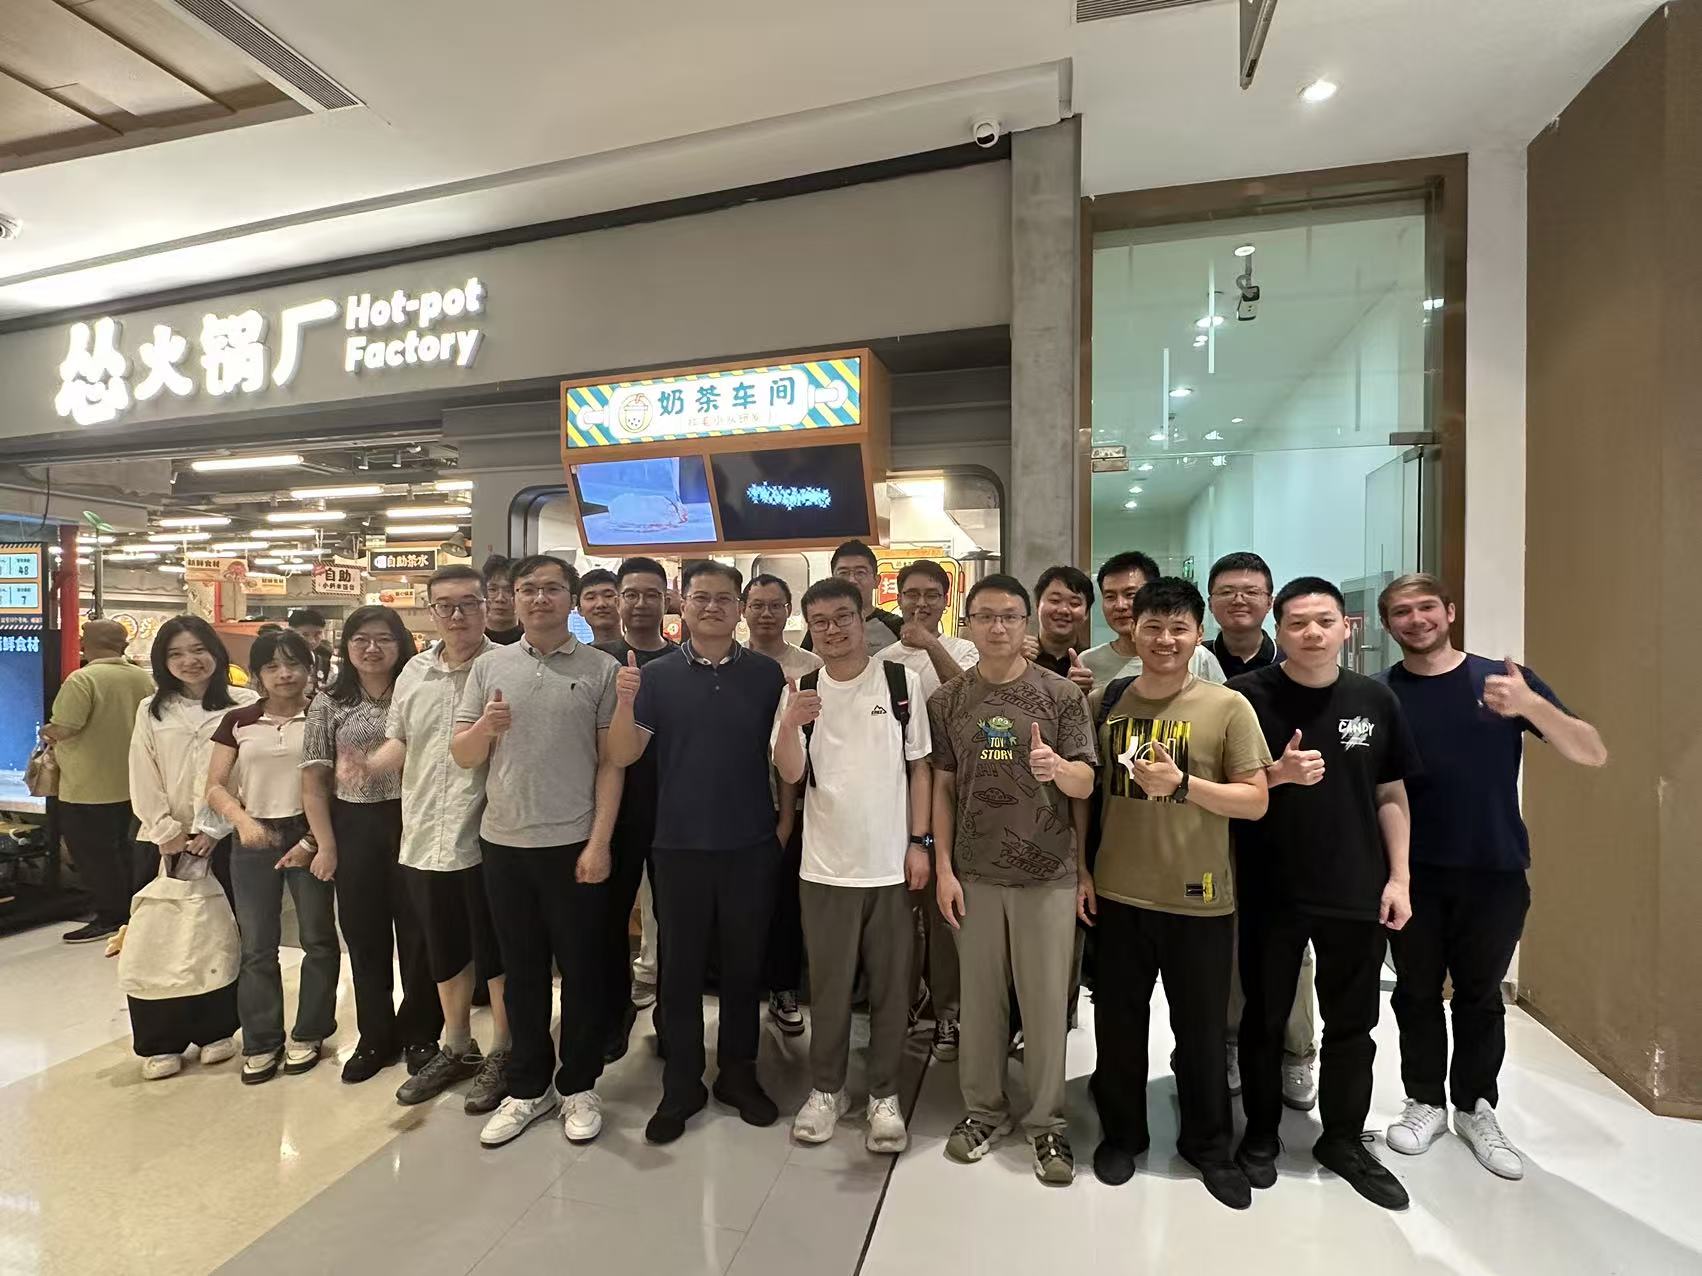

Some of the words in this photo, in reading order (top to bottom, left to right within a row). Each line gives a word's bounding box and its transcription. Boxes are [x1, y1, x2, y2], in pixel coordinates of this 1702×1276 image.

[345, 277, 485, 330] Hot-pot
[345, 329, 481, 373] Factory
[54, 298, 341, 426] 怂火锅厂
[657, 376, 796, 417] 奶茶车间
[387, 554, 429, 568] 自助茶水
[325, 567, 351, 582] 自助
[0, 636, 39, 652] 鲜食材
[990, 736, 1004, 748] TOY
[979, 749, 1014, 761] STORY
